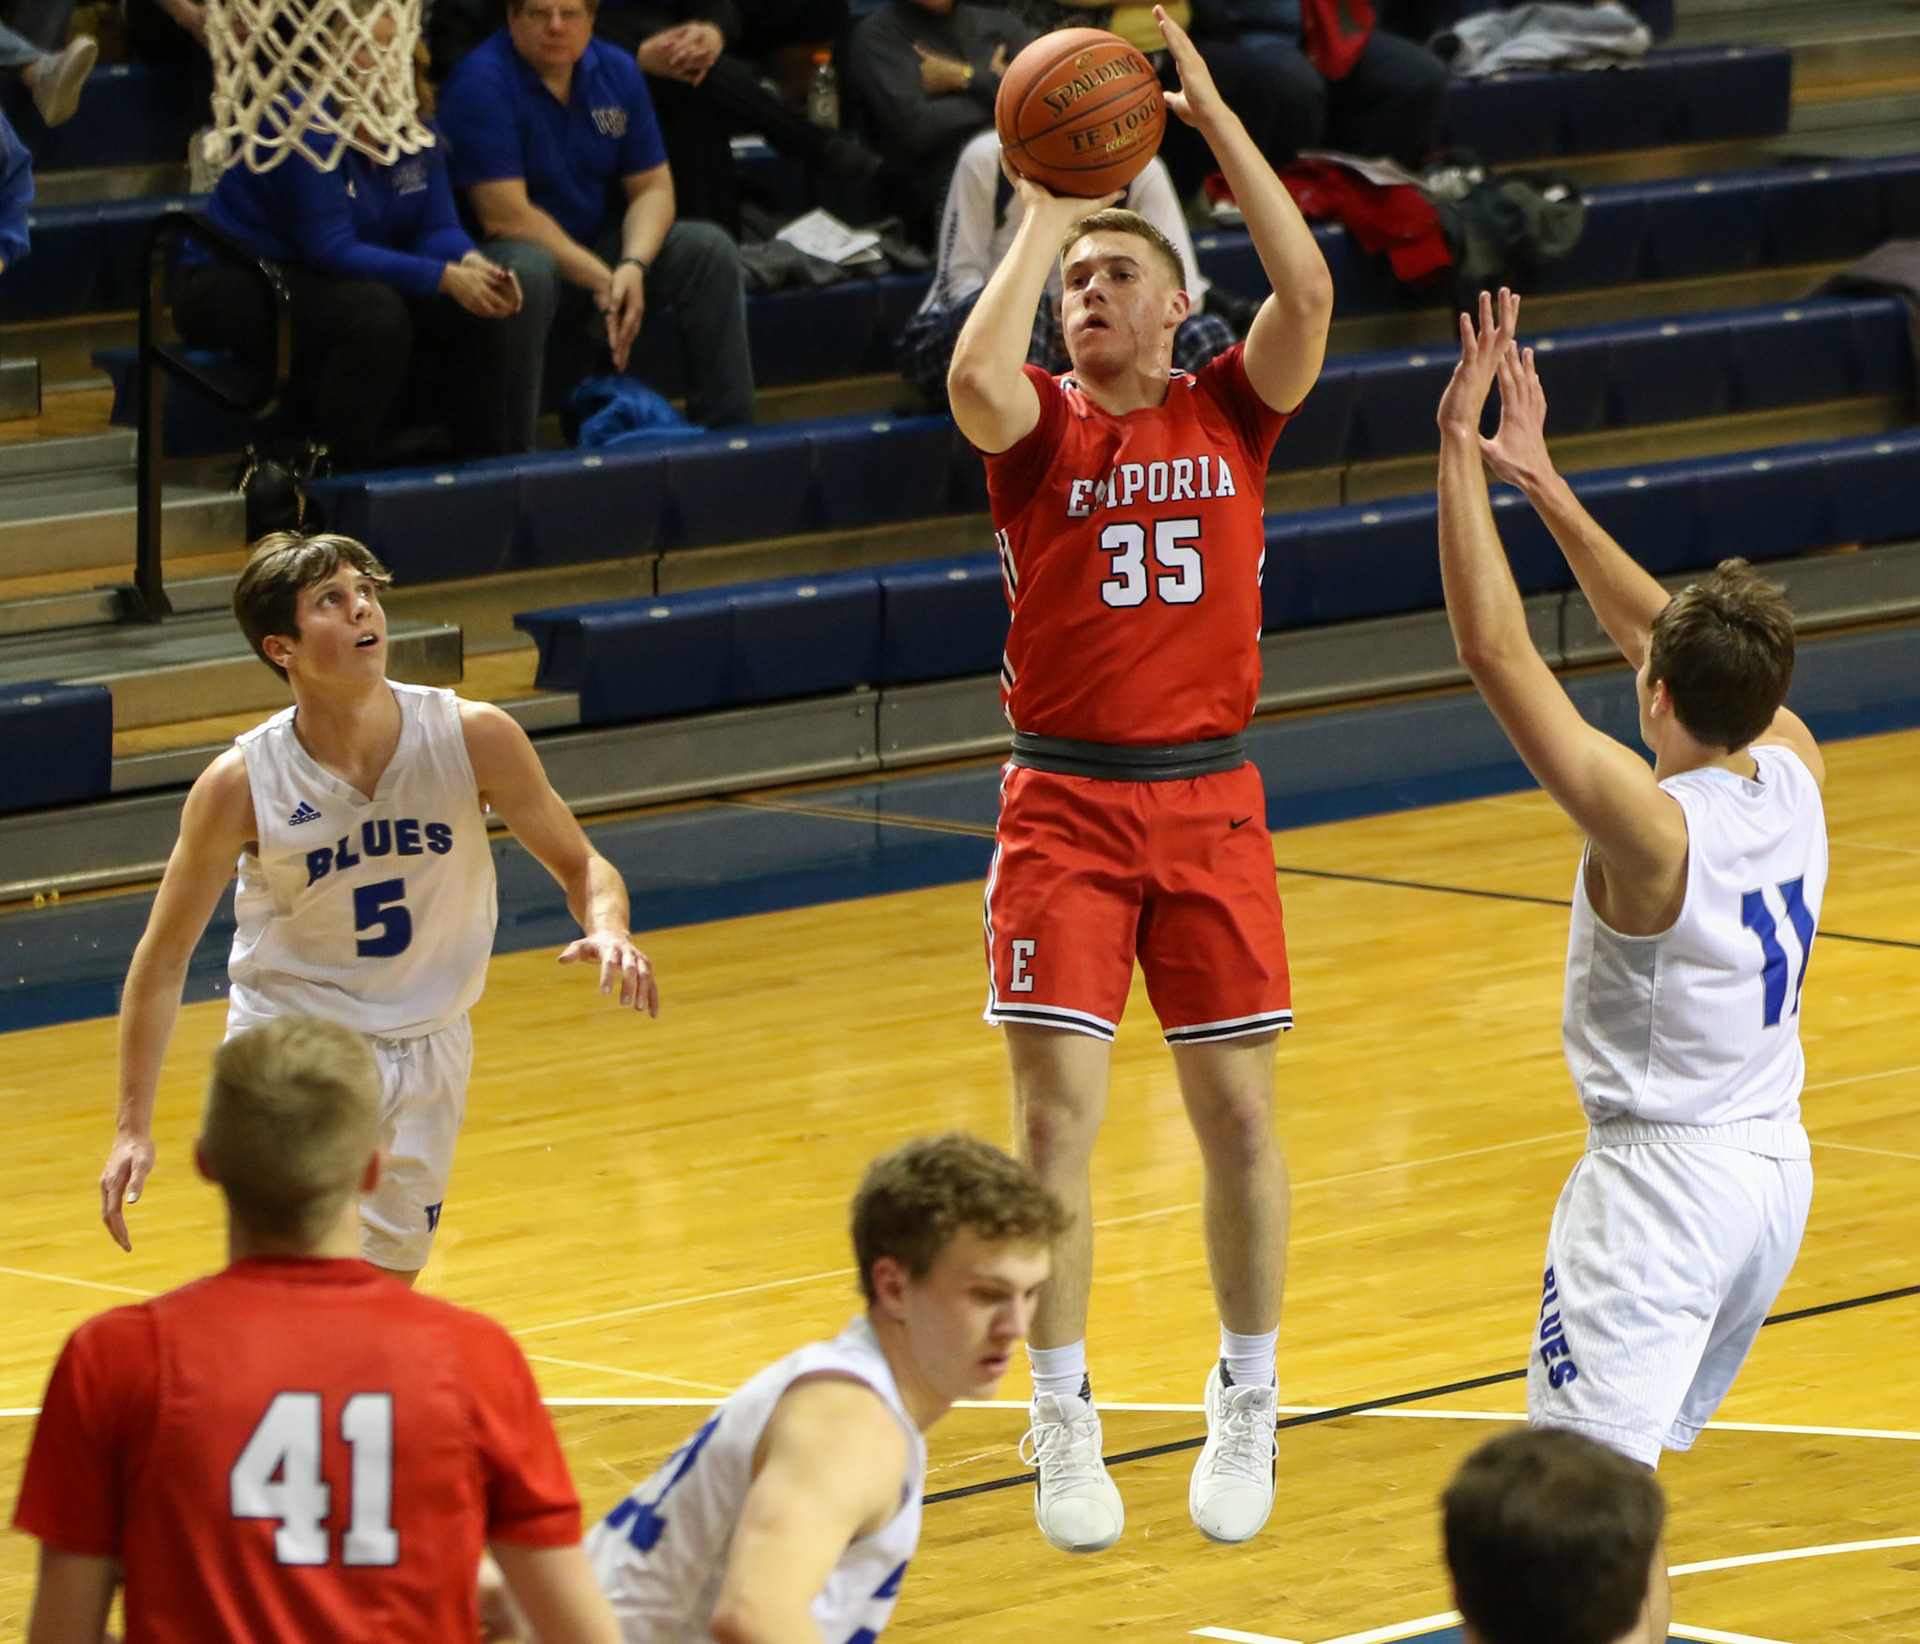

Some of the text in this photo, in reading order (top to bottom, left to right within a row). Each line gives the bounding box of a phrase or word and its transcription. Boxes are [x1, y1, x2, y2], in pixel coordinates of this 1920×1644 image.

[1043, 53, 1144, 118] SPALDING
[1067, 455, 1236, 517] EMPORIA
[1100, 516, 1203, 608] 35
[288, 811, 321, 826] adidas
[306, 819, 453, 888] BLUES
[353, 877, 413, 958] 5
[1740, 873, 1814, 1030] 11
[1010, 939, 1036, 992] E
[1540, 1264, 1578, 1389] BLUES
[230, 1391, 399, 1566] 41
